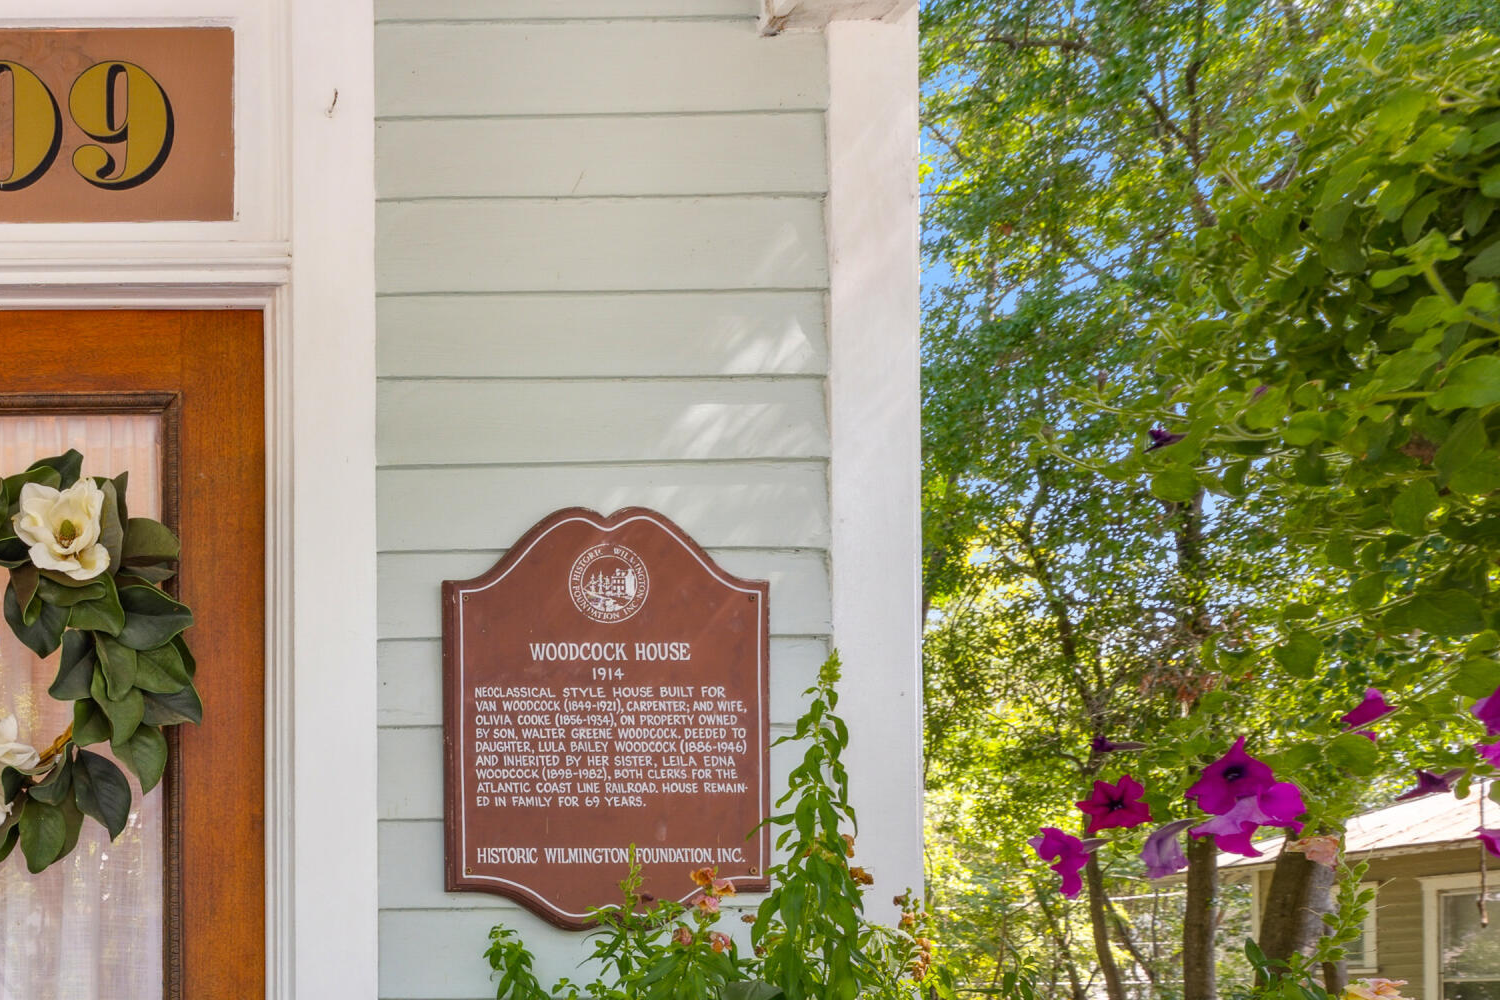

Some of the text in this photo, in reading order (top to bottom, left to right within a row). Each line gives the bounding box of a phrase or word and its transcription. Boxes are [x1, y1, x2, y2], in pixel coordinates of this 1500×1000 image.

[530, 642, 692, 661] WOODCOCK HOUSE
[592, 667, 624, 681] 1914
[475, 686, 725, 698] NEOCLASSICAL STYLE HOUSE BUILT FOR
[475, 699, 747, 713] VAN WOODCOCK (1849-1921), CARPENTER; AND WIFE,
[475, 713, 737, 727] OLIVIA COOKE (1856-1934), ON PROPERTY OWNED
[476, 728, 746, 740] BY SON, WALTER GREENE WOODCOCK. DEEDED TO
[475, 740, 747, 755] DAUGHTER, LULA BAILEY WOODCOCK (1886-1946)
[475, 755, 735, 769] AND INHERITED BY HER SISTER, LEILA EDNA
[476, 767, 738, 781] WOODCOCK (1898-1982), BOTH CLERKS FOR THE
[477, 782, 748, 794] ATLANTIC COAST LINE RAILROAD. HOUSE REMAIN-
[476, 796, 646, 807] ED IN FAMILY FOR 69 YEARS.
[477, 847, 745, 865] HISTORIC WILMINGTON FOUNDATION, INC.
